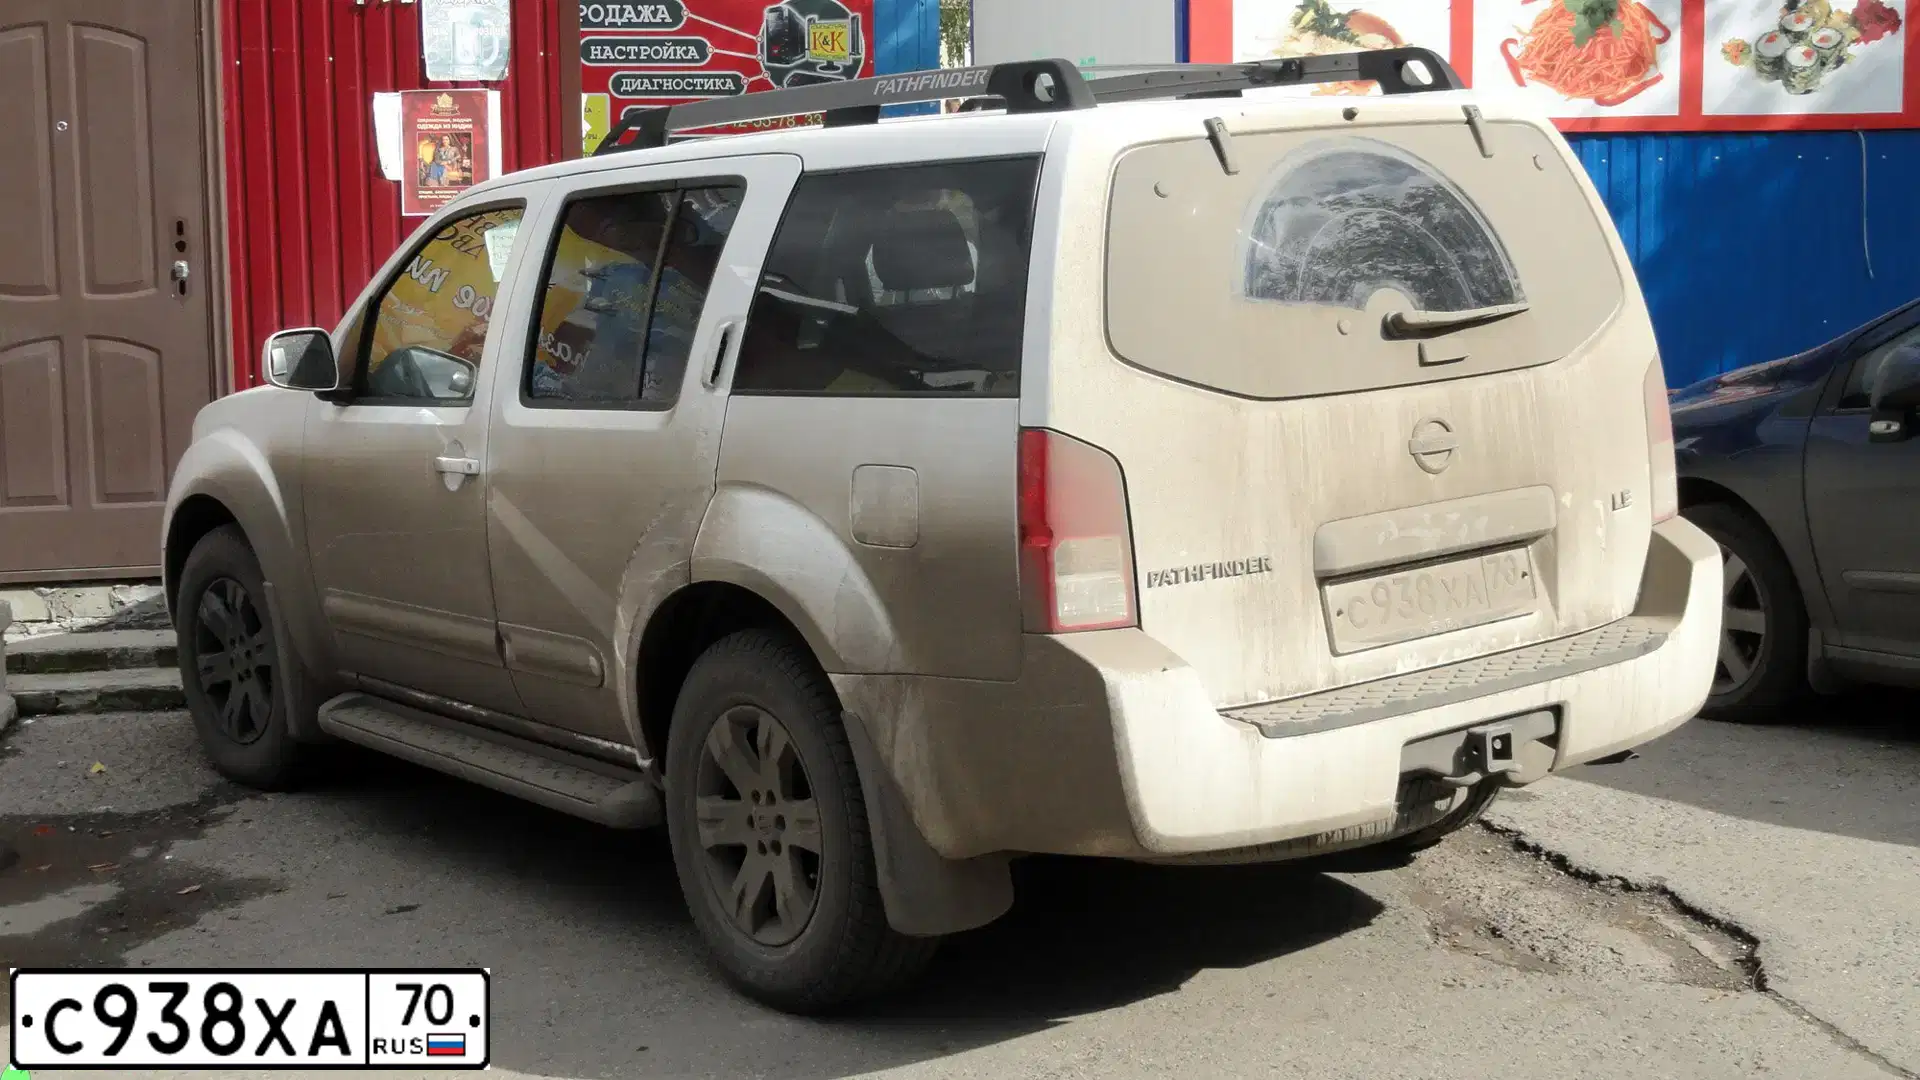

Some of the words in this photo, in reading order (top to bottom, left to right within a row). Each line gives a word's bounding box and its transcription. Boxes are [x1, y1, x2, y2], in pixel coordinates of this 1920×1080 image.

[590, 42, 700, 60] НАСТРОЙКА
[620, 78, 736, 93] ДИАГНОСТИКА
[873, 69, 989, 96] PATHFINDER
[1611, 489, 1633, 512] LE
[1146, 555, 1273, 588] PATHFINDER
